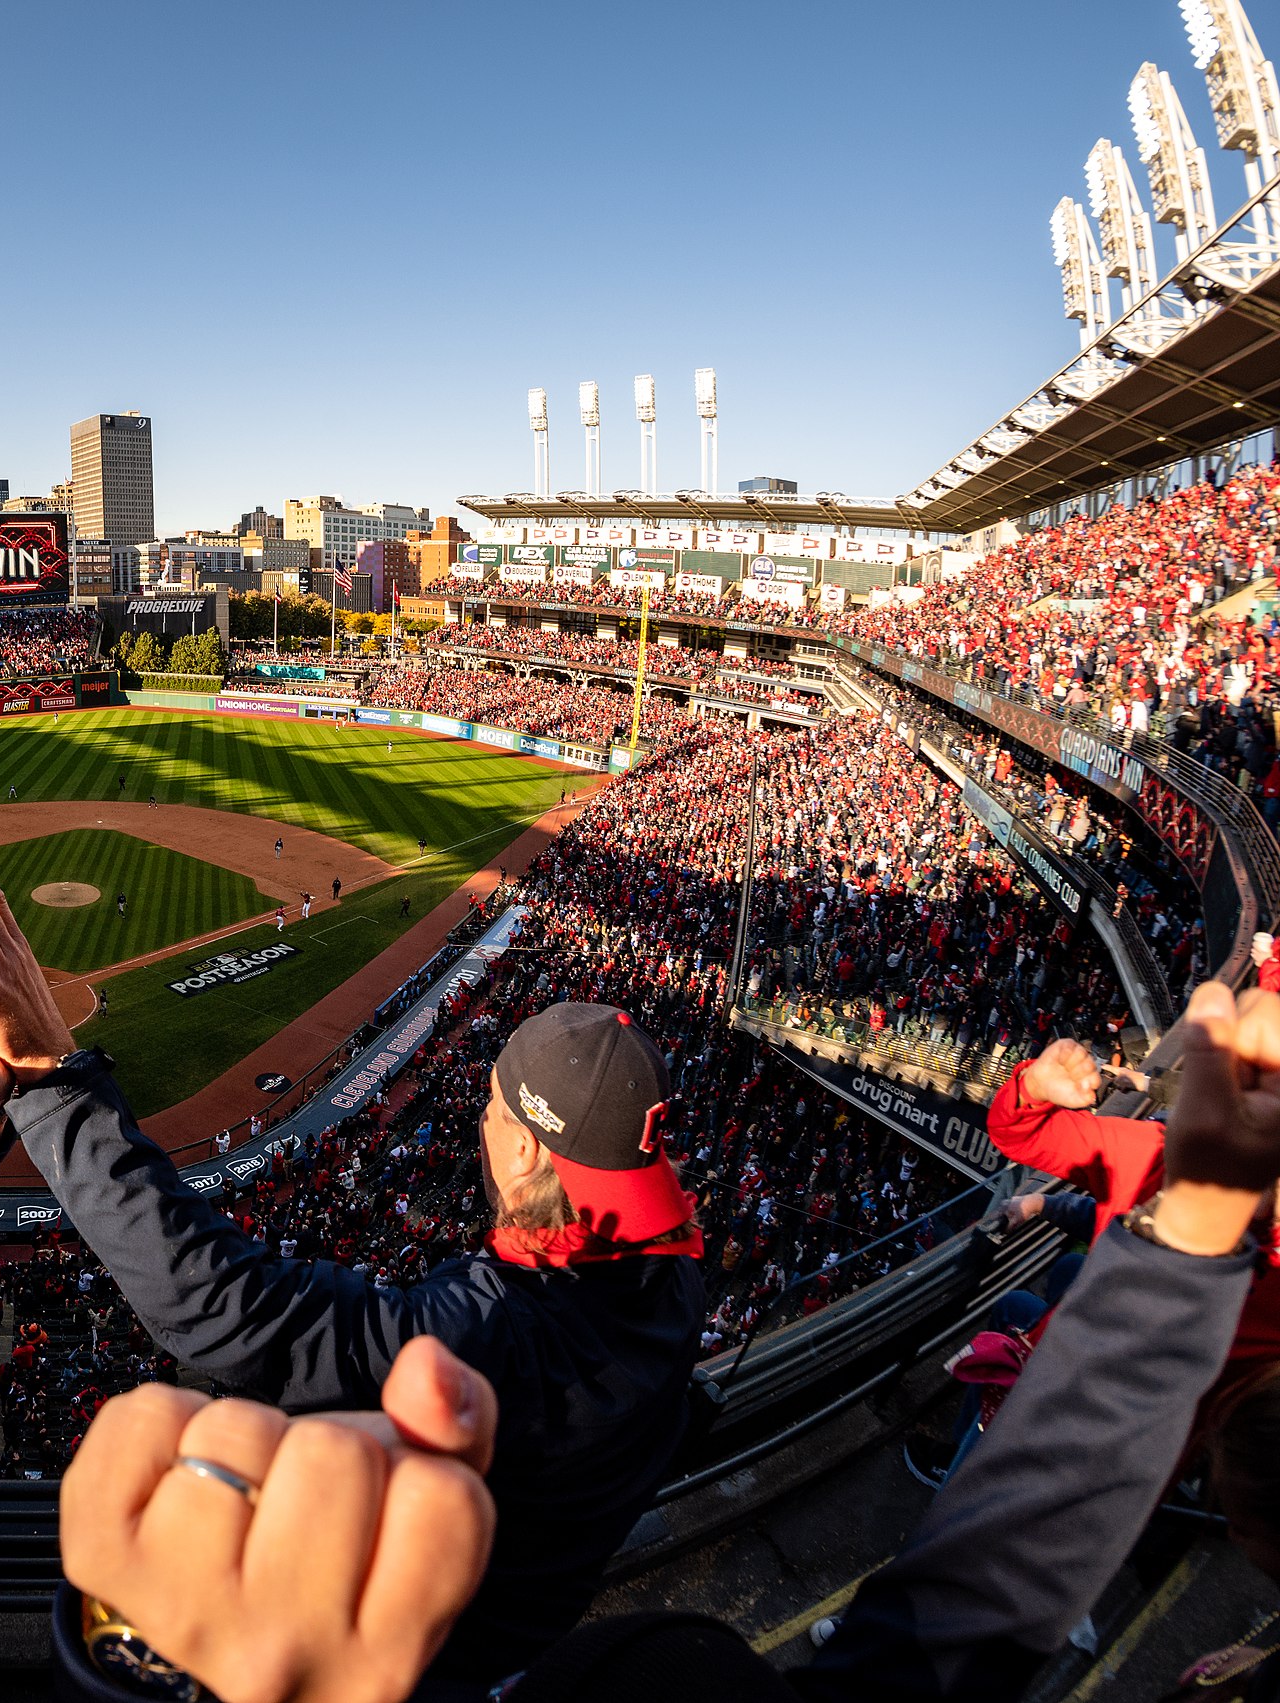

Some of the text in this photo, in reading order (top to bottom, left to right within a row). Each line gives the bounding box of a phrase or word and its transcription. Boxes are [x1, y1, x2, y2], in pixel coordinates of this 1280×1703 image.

[513, 547, 547, 559] DEX
[461, 565, 480, 573] FELLER
[512, 567, 542, 576] BOUDREAU
[565, 570, 589, 579] AVERILL
[692, 577, 716, 588] THOME
[768, 584, 788, 594] DOBY
[127, 600, 205, 614] PROGRESSIVE
[726, 621, 760, 631] GUARDIANS
[81, 681, 109, 692] meijer
[477, 728, 512, 747] MOEN
[520, 738, 558, 756] DollarBank
[1060, 728, 1144, 793] GUARDIANS WIN
[1061, 882, 1080, 913] CLUB
[170, 943, 295, 994] POSTSEASON
[387, 1006, 438, 1054] GUARDIANS
[331, 1052, 400, 1109] CLEVELAND
[878, 1079, 917, 1103] DISCOUNT
[852, 1075, 1002, 1172] drug mart CLUB
[234, 1158, 261, 1175] 2018
[21, 1210, 54, 1219] 2007
